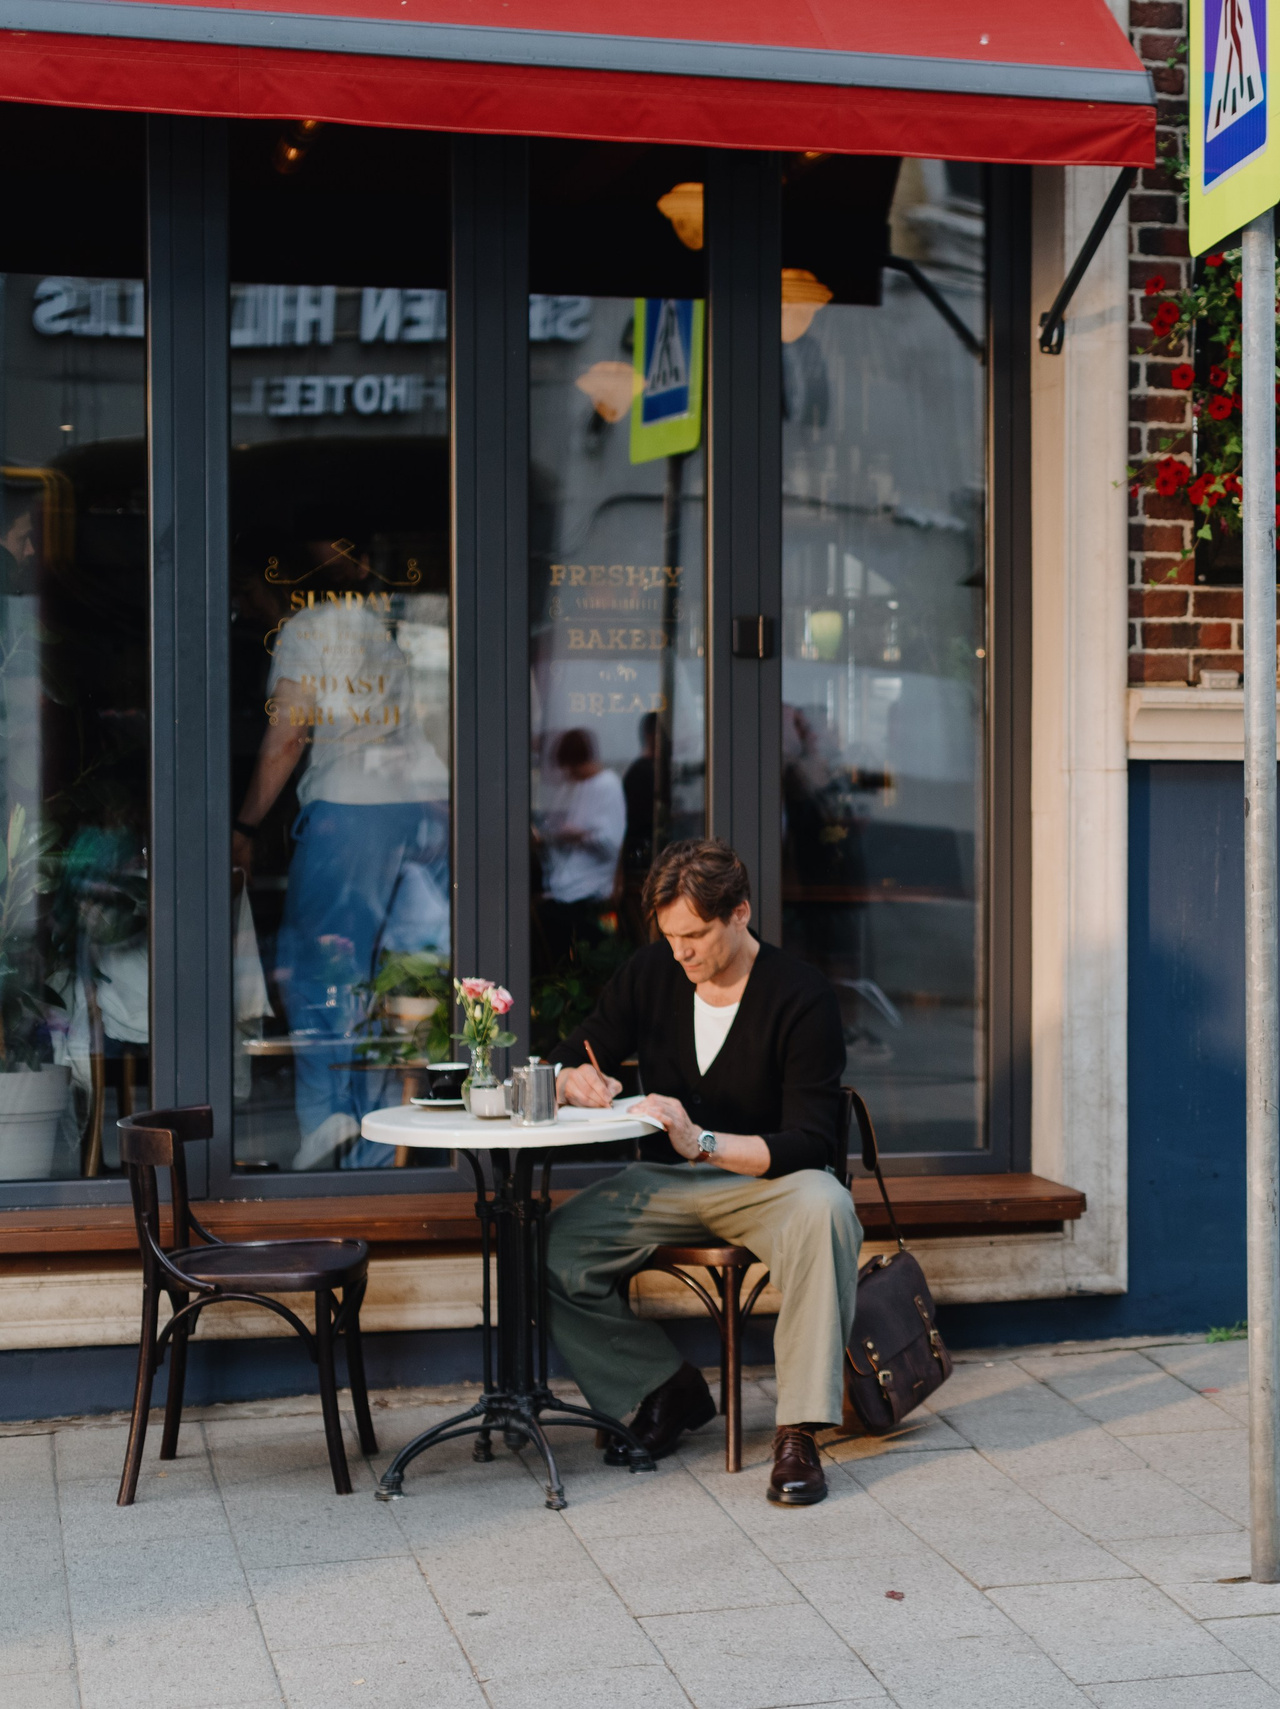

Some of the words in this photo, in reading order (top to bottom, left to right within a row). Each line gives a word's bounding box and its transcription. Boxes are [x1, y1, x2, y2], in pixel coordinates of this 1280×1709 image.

[549, 564, 684, 588] FRESHLY
[290, 589, 395, 612] SUNDAY
[567, 628, 669, 651] BAKED
[301, 673, 391, 695] ROAST
[568, 692, 668, 713] BREAD
[289, 704, 401, 727] BRUNCH
